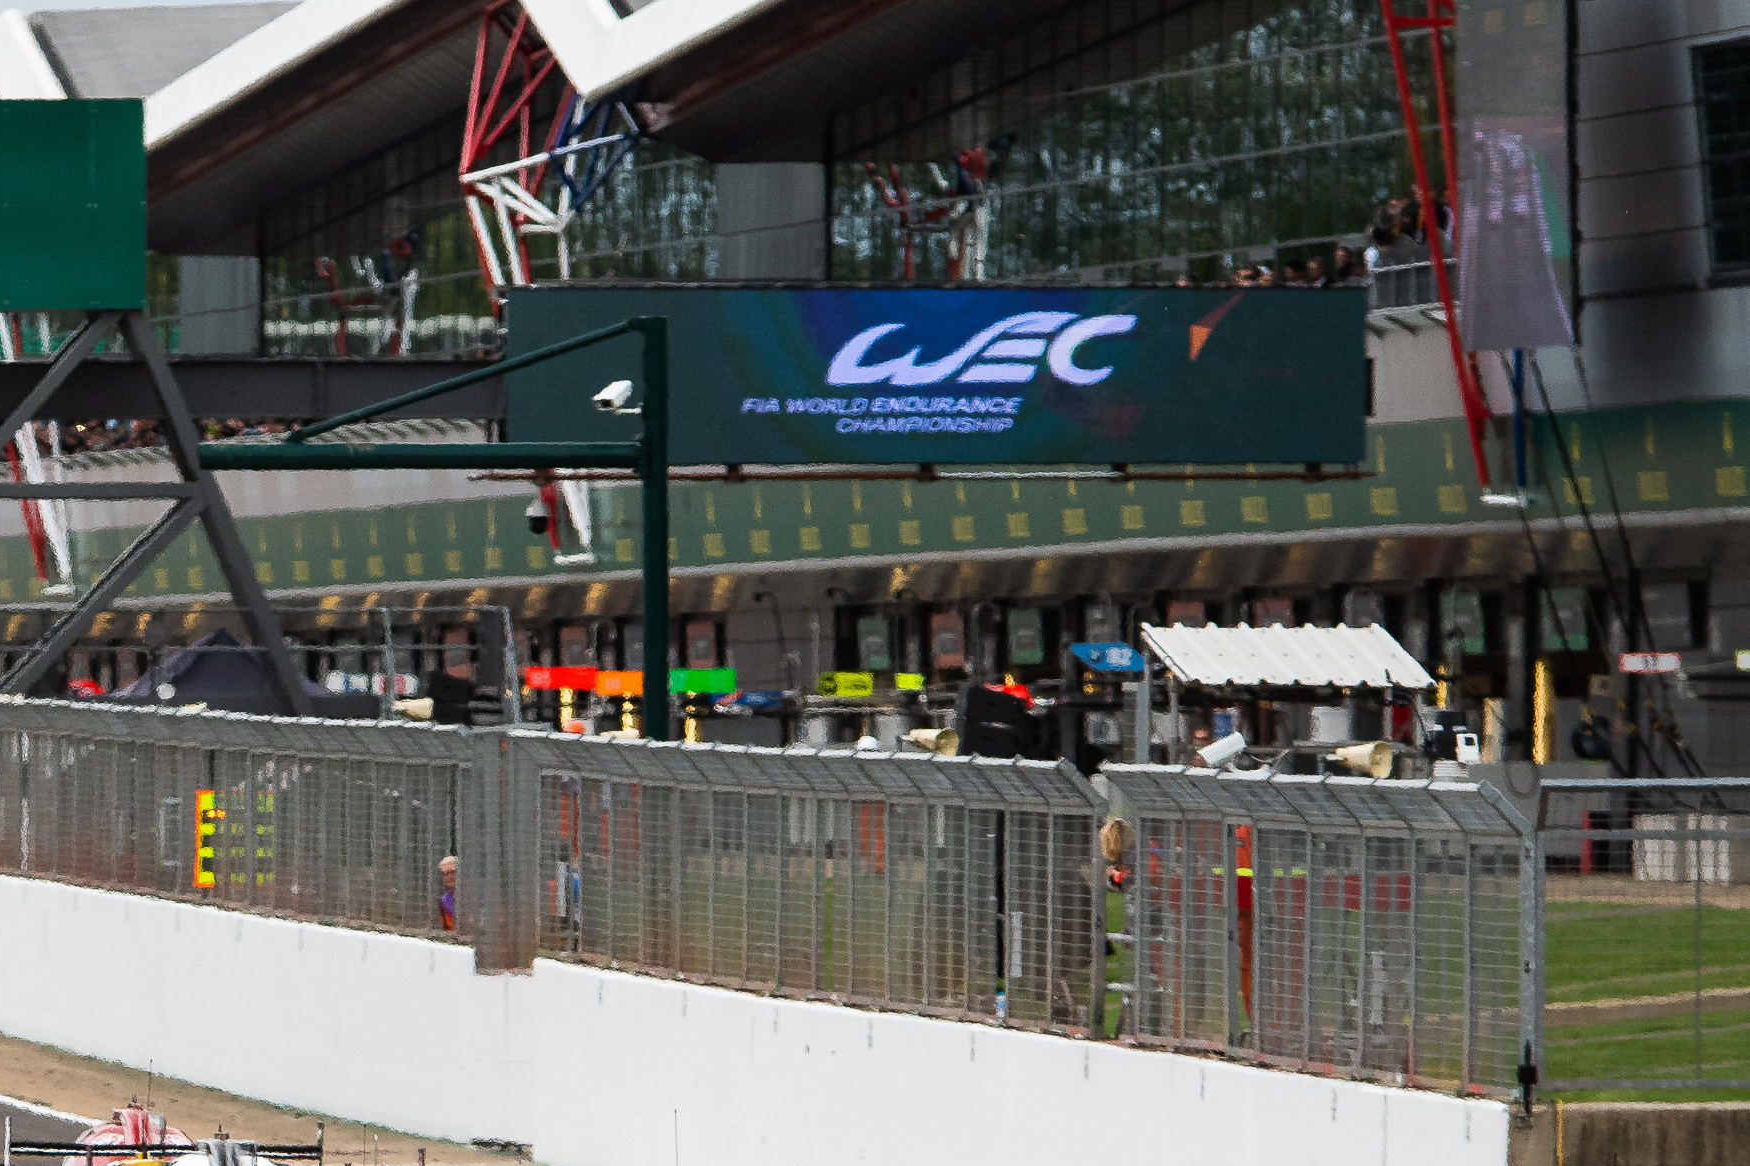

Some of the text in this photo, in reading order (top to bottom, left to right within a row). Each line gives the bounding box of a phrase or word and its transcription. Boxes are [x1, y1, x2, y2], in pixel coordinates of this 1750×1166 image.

[825, 311, 1138, 386] WEC
[741, 396, 1024, 414] FIA WORLD ENDURANCE
[836, 416, 1014, 433] CHAMPIONSHIP
